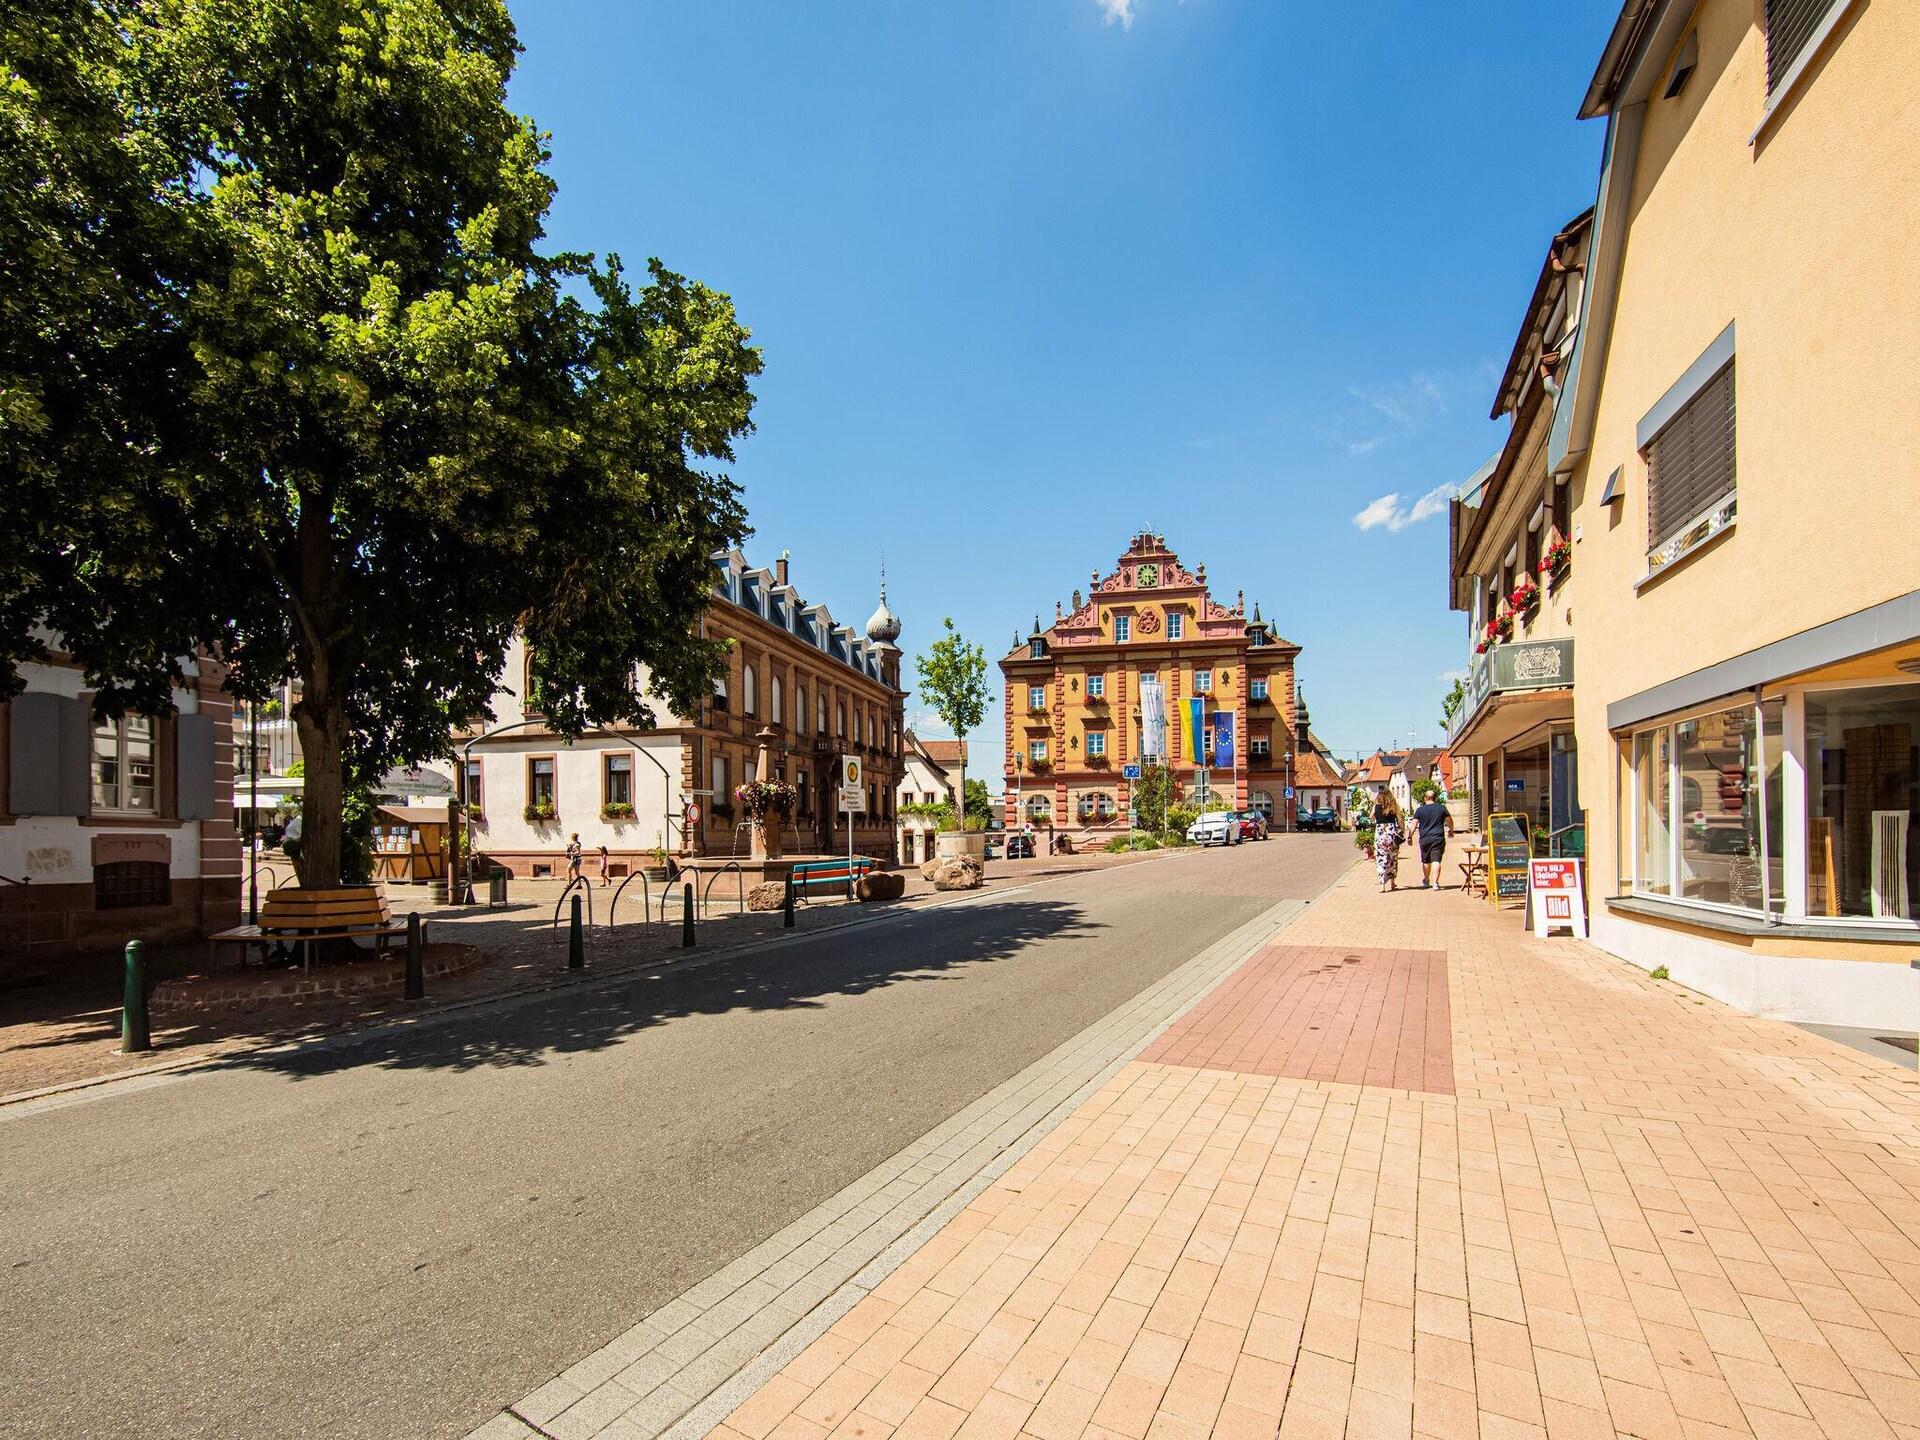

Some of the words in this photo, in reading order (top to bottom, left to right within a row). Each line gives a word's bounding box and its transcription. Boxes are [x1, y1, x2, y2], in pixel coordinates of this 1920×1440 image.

[1549, 864, 1565, 872] BILD
[1535, 871, 1559, 880] täglich
[1535, 879, 1551, 887] hier.
[1547, 897, 1570, 917] Bild
